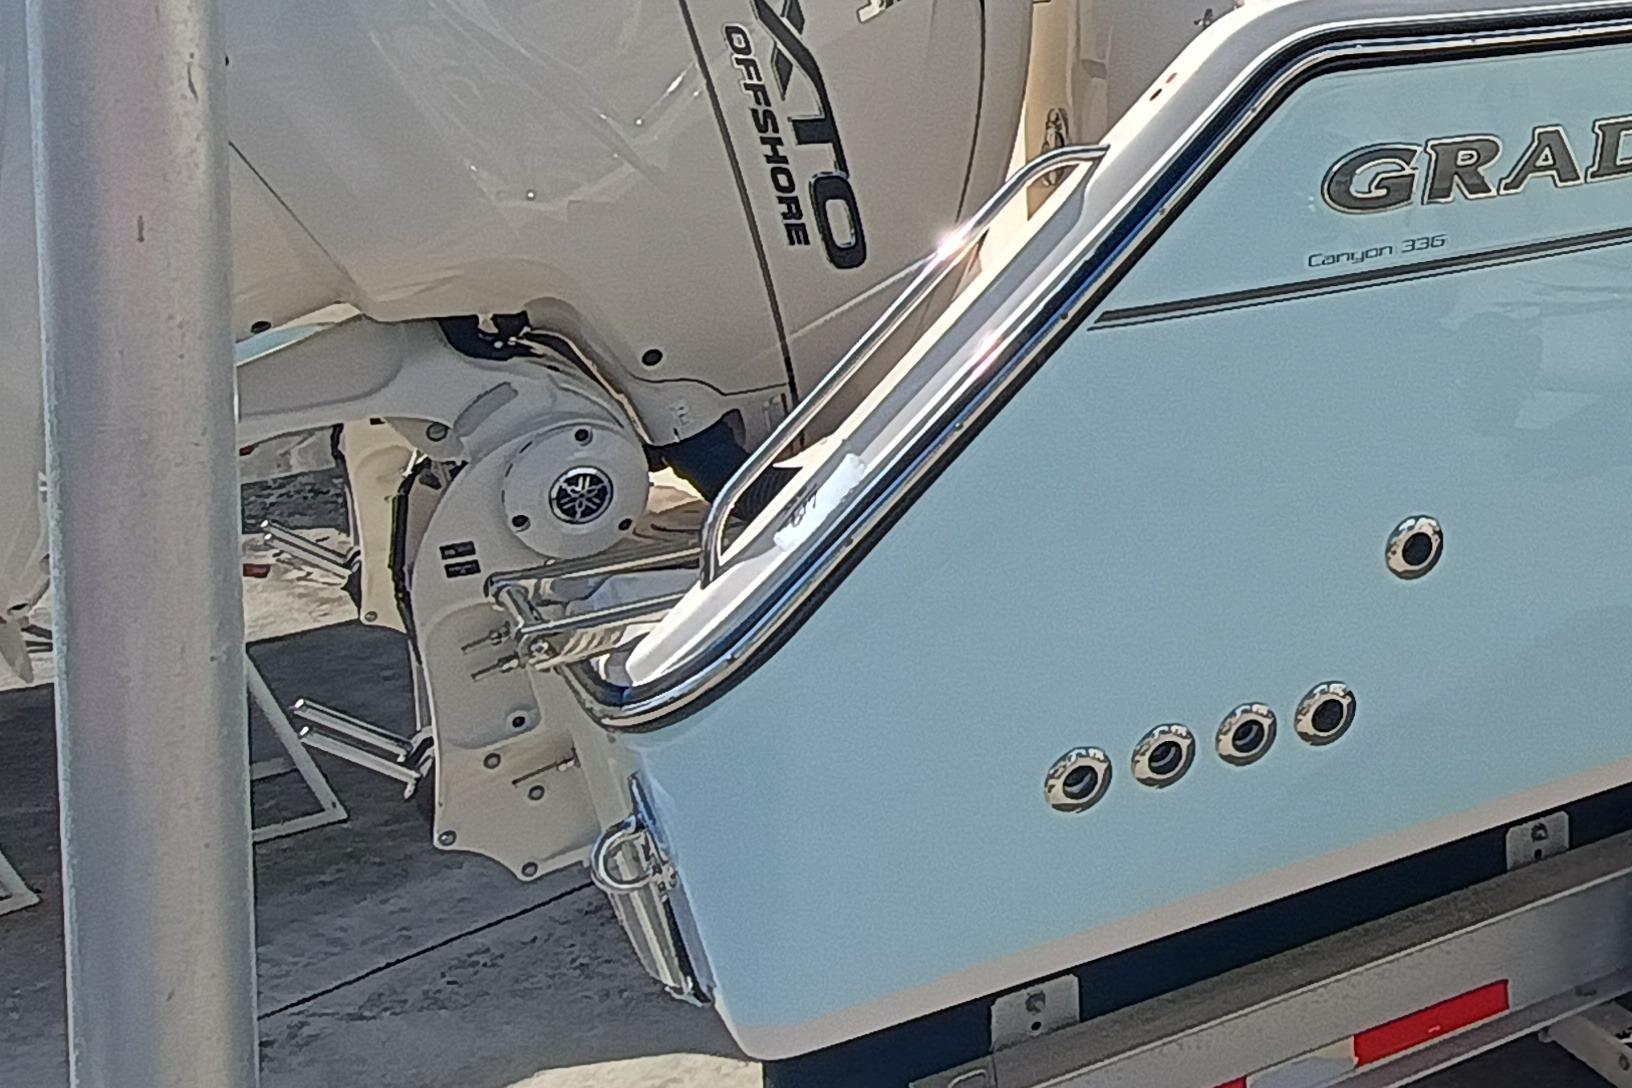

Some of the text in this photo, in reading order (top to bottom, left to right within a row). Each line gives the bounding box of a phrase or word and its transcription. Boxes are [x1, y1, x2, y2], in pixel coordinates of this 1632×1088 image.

[723, 23, 810, 247] OFFSHORE
[1308, 233, 1447, 267] Canyon 336
